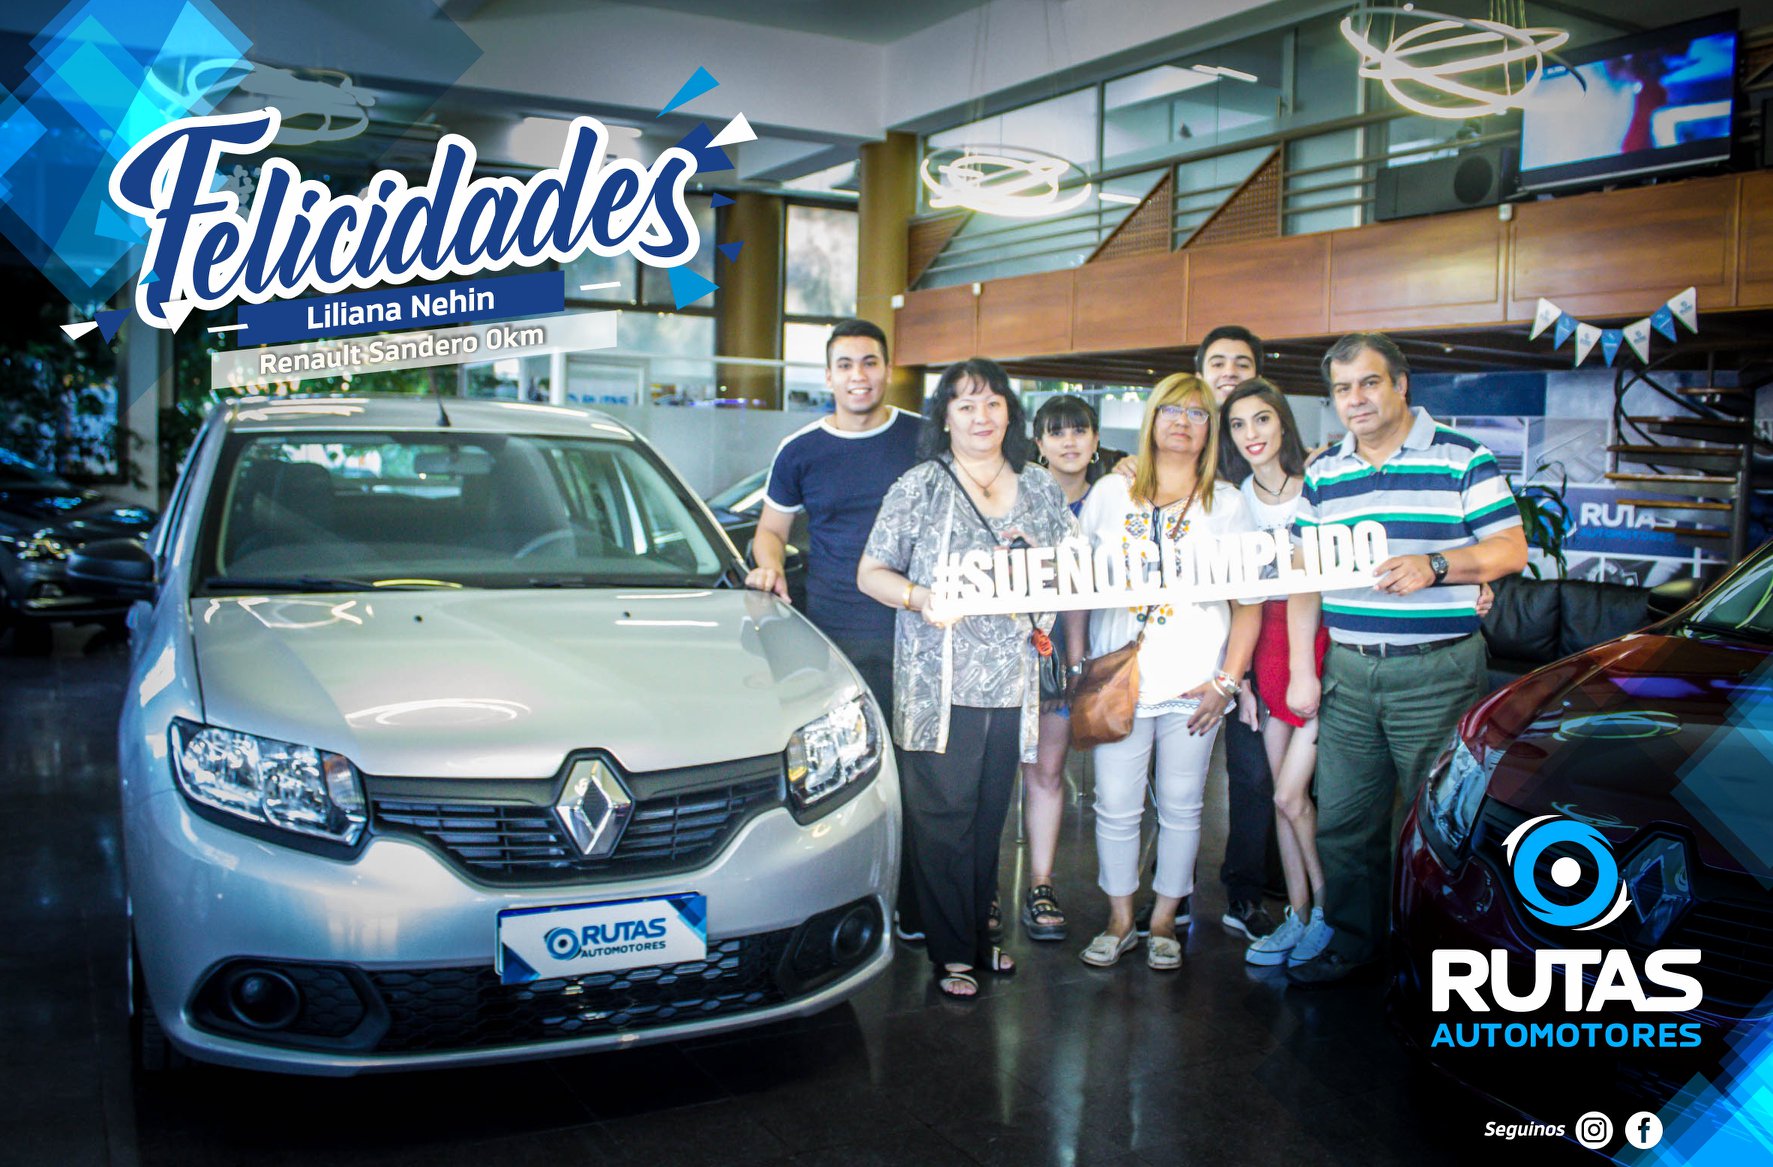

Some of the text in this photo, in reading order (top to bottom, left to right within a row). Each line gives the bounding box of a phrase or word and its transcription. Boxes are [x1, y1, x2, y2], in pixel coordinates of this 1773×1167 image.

[931, 519, 1389, 600] #SUEÑOCUMPLIDO
[581, 917, 666, 946] RUTAS
[580, 940, 666, 958] AUTOMOTORES
